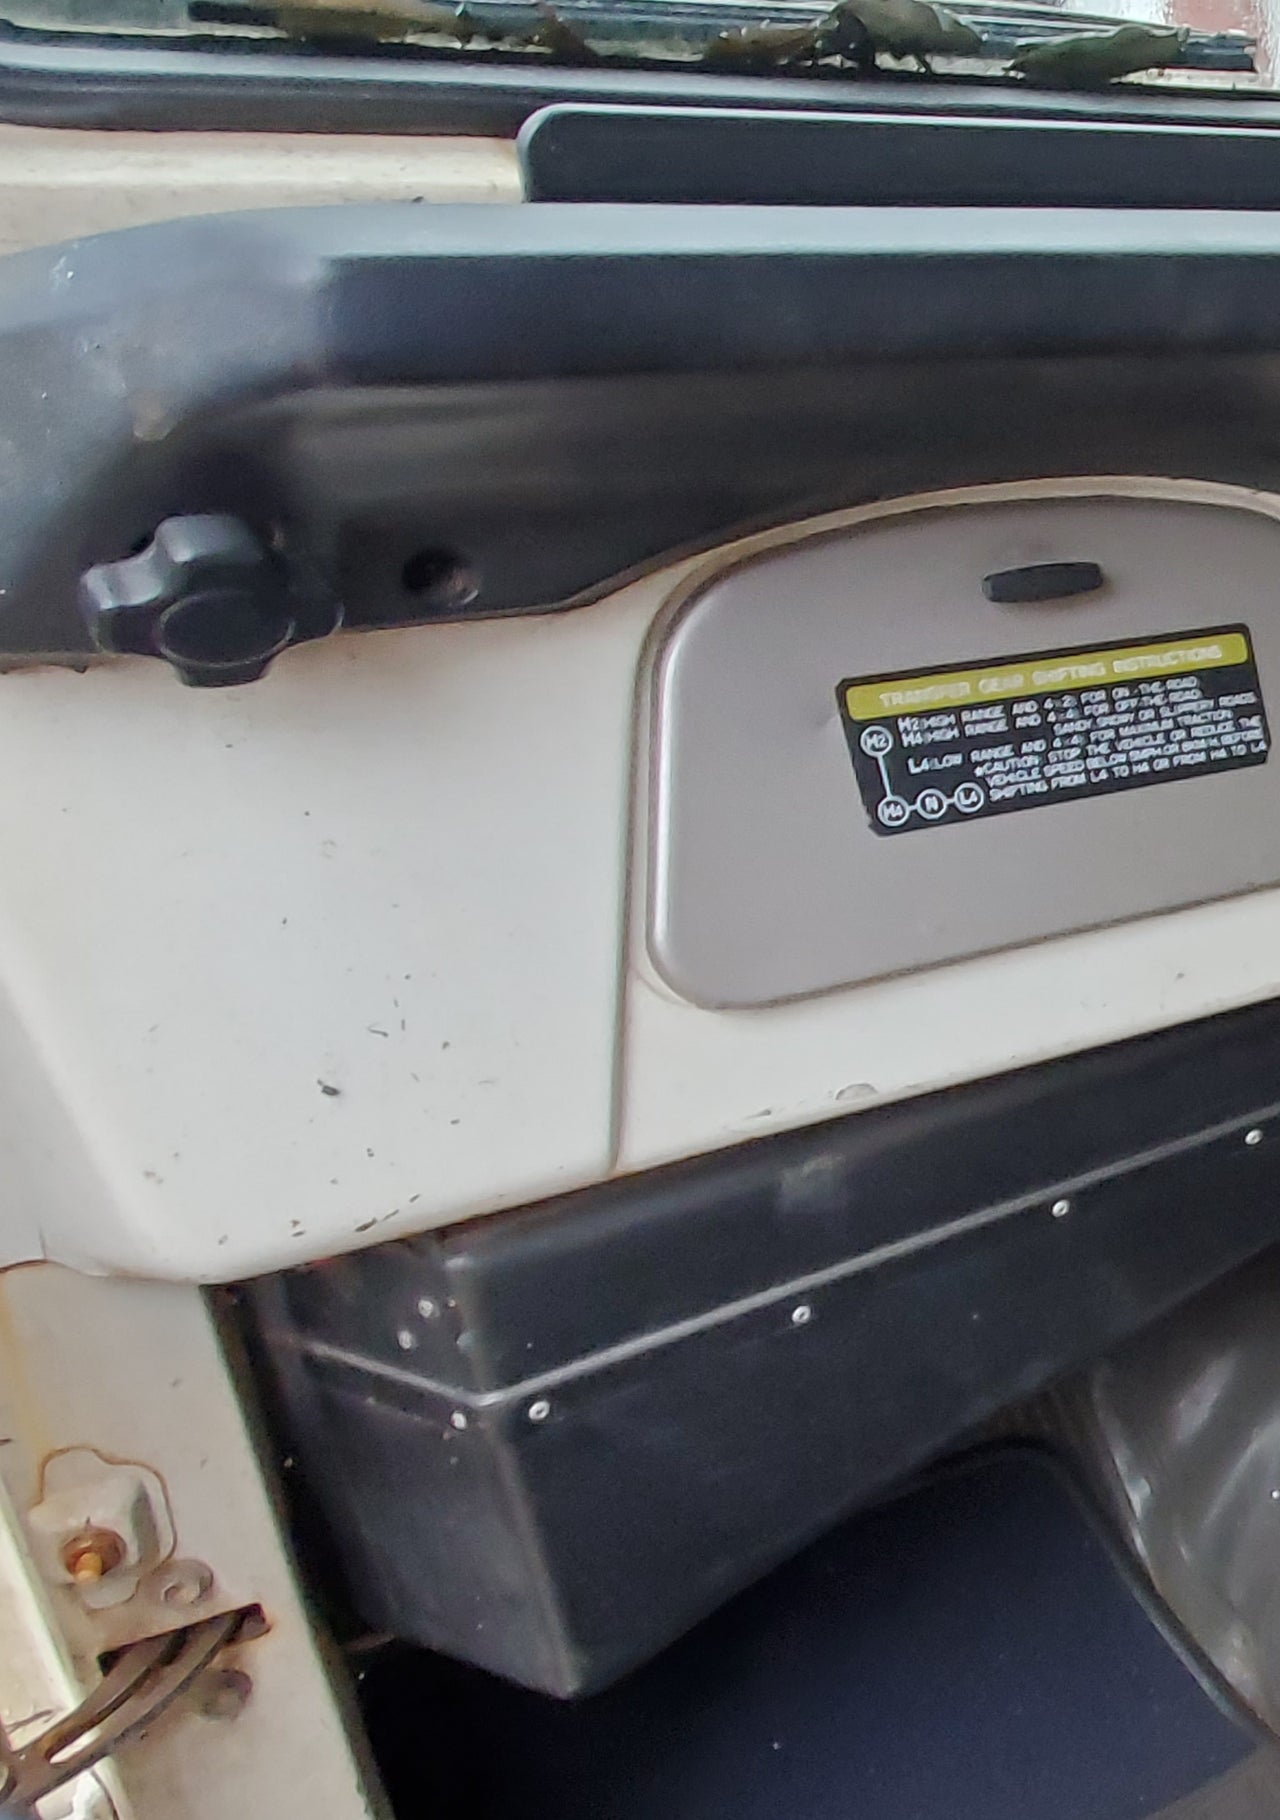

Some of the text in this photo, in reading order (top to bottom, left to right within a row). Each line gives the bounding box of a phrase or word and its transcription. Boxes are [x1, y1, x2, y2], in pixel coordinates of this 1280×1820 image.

[1012, 700, 1038, 715] AND
[1080, 690, 1106, 704] FOR
[1016, 713, 1041, 728] AND
[1084, 702, 1109, 716] FOR
[1021, 739, 1046, 754] AND
[1089, 728, 1116, 742] FOR
[1048, 747, 1081, 763] STOP
[1086, 742, 1110, 755] THE
[1115, 732, 1166, 751] VEHICLE
[1112, 765, 1129, 778] TO
